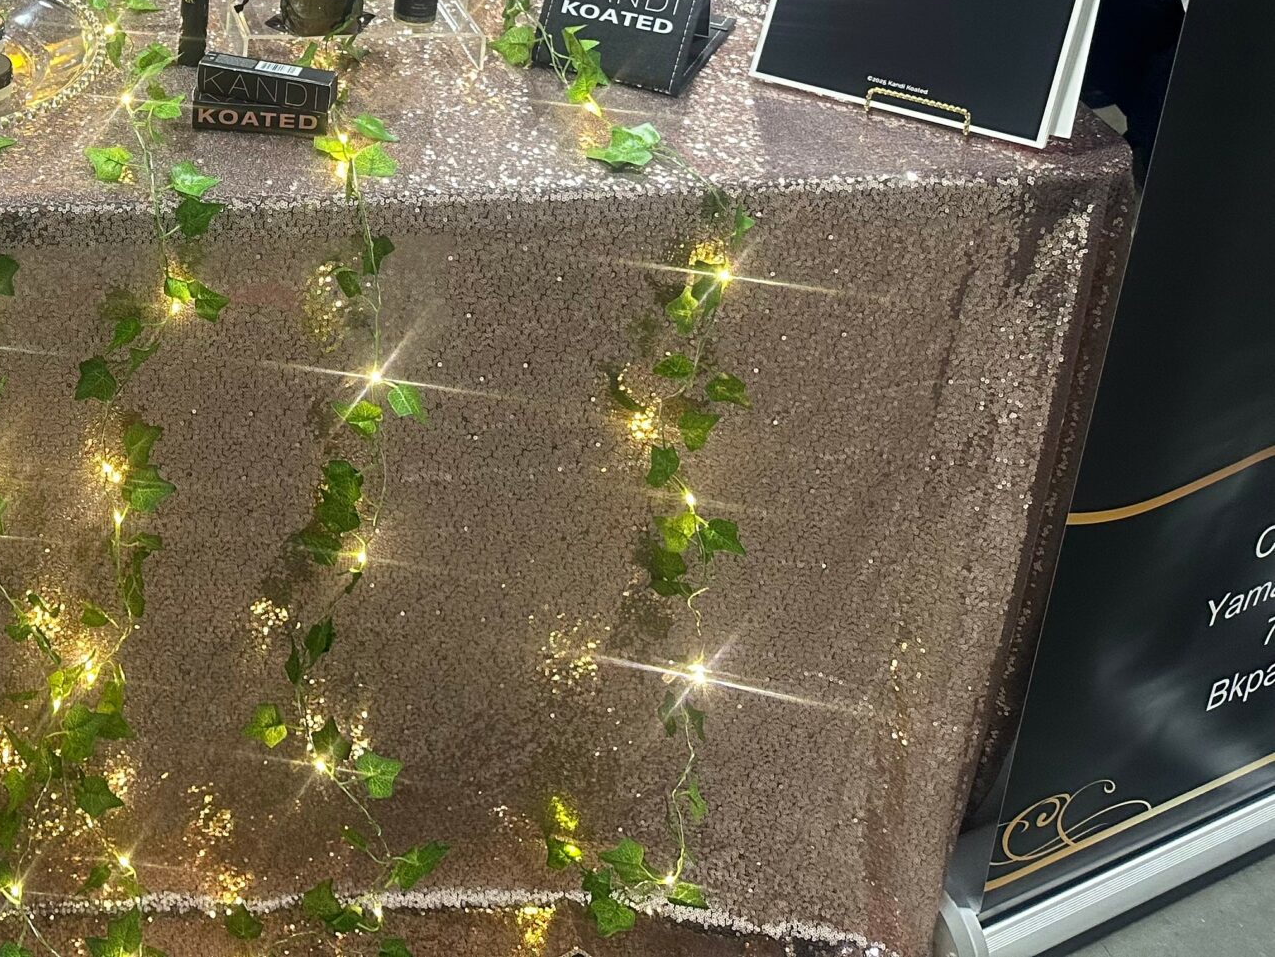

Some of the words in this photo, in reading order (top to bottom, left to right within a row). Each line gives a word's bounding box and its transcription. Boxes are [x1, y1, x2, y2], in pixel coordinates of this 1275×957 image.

[560, 0, 673, 34] KOATED
[203, 67, 320, 111] KANDI
[197, 108, 319, 130] KOATED
